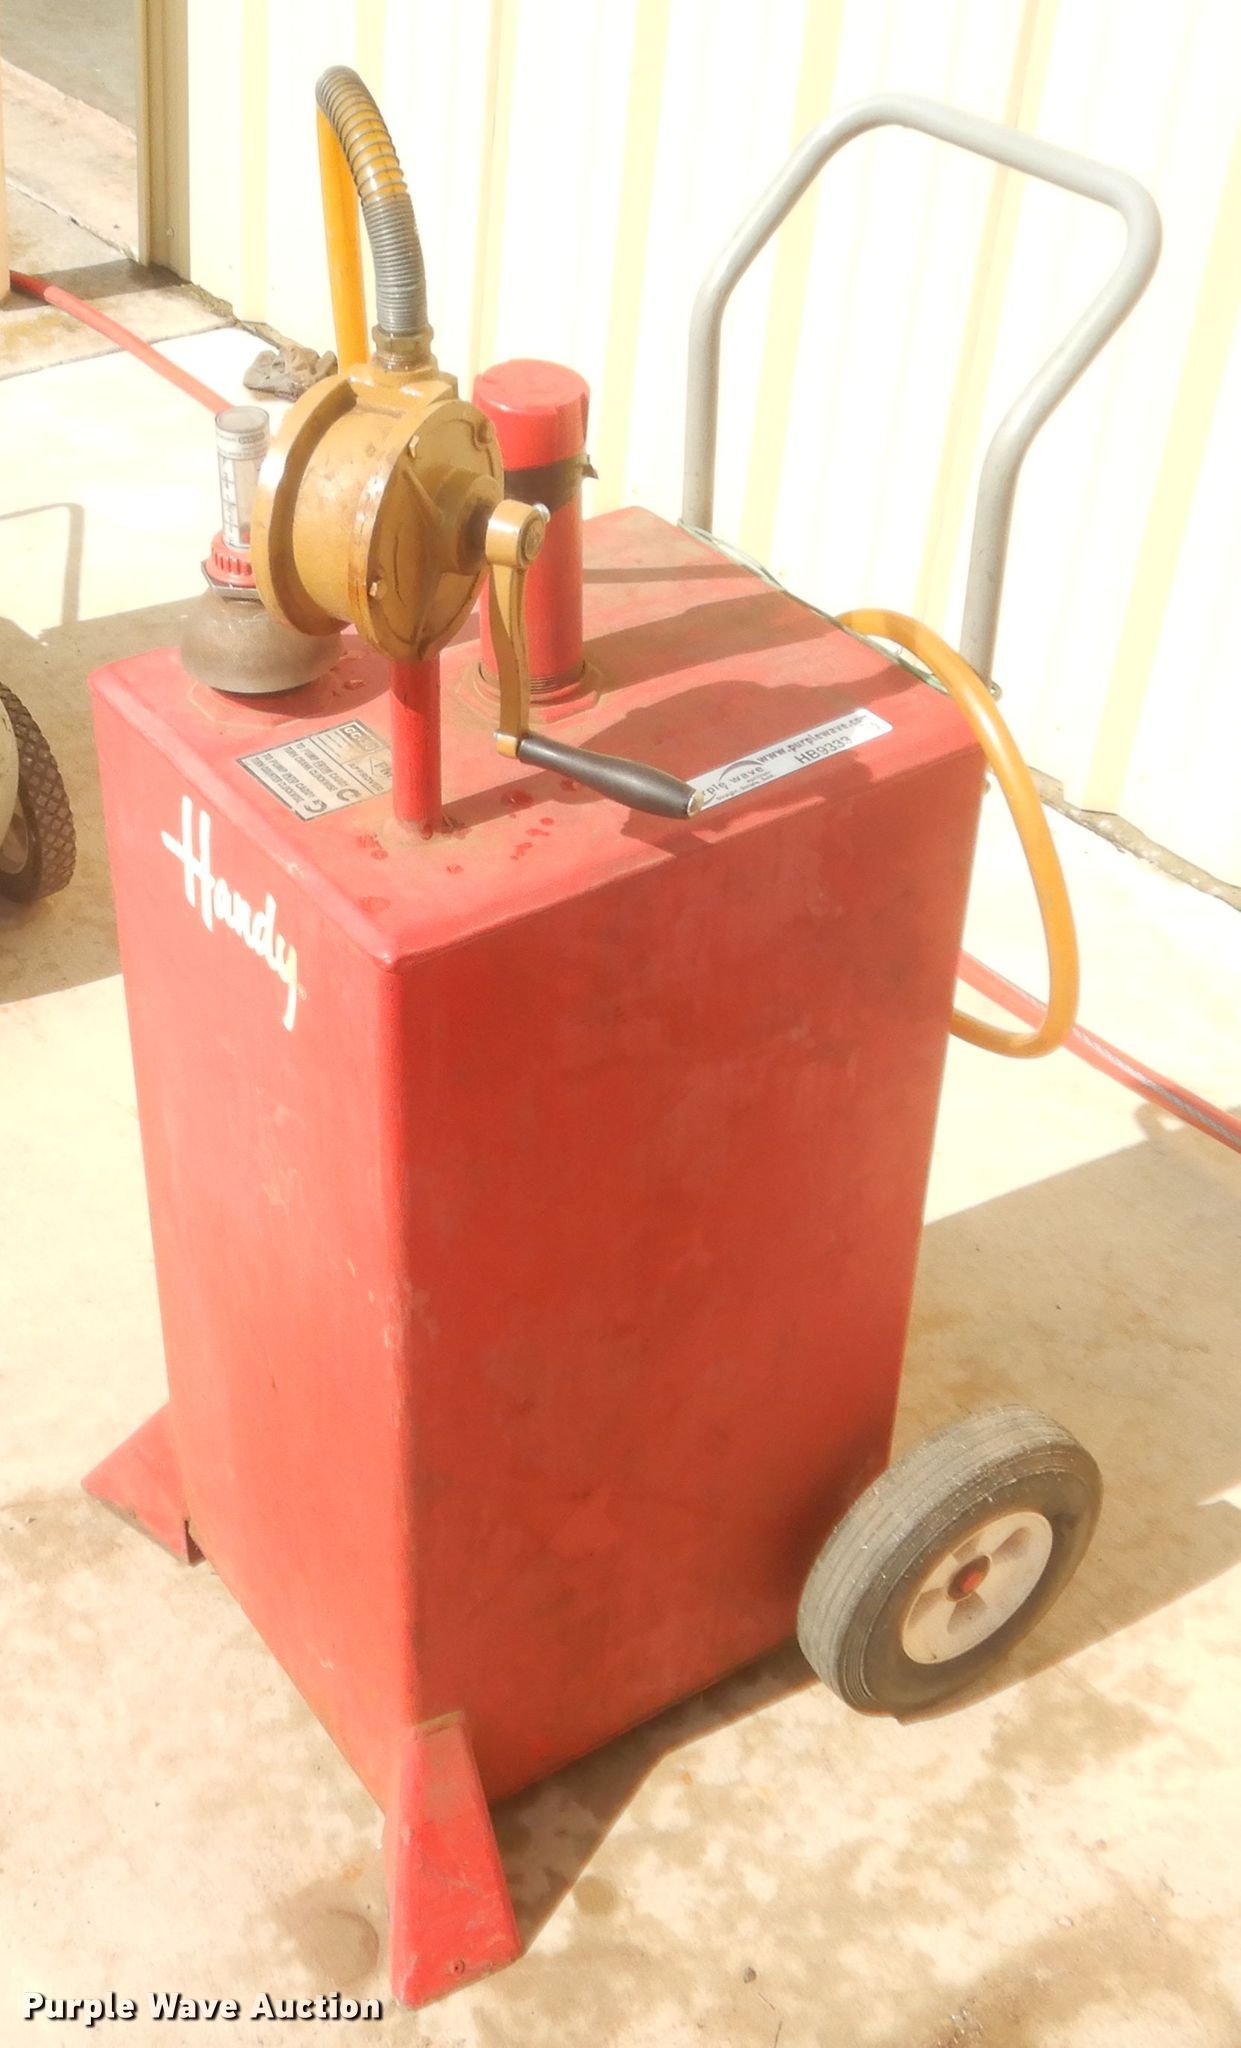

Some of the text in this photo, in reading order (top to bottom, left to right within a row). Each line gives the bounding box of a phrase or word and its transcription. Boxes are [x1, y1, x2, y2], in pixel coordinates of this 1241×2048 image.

[794, 735, 851, 764] HB9333
[729, 766, 764, 783] wave
[161, 795, 298, 1032] Handy
